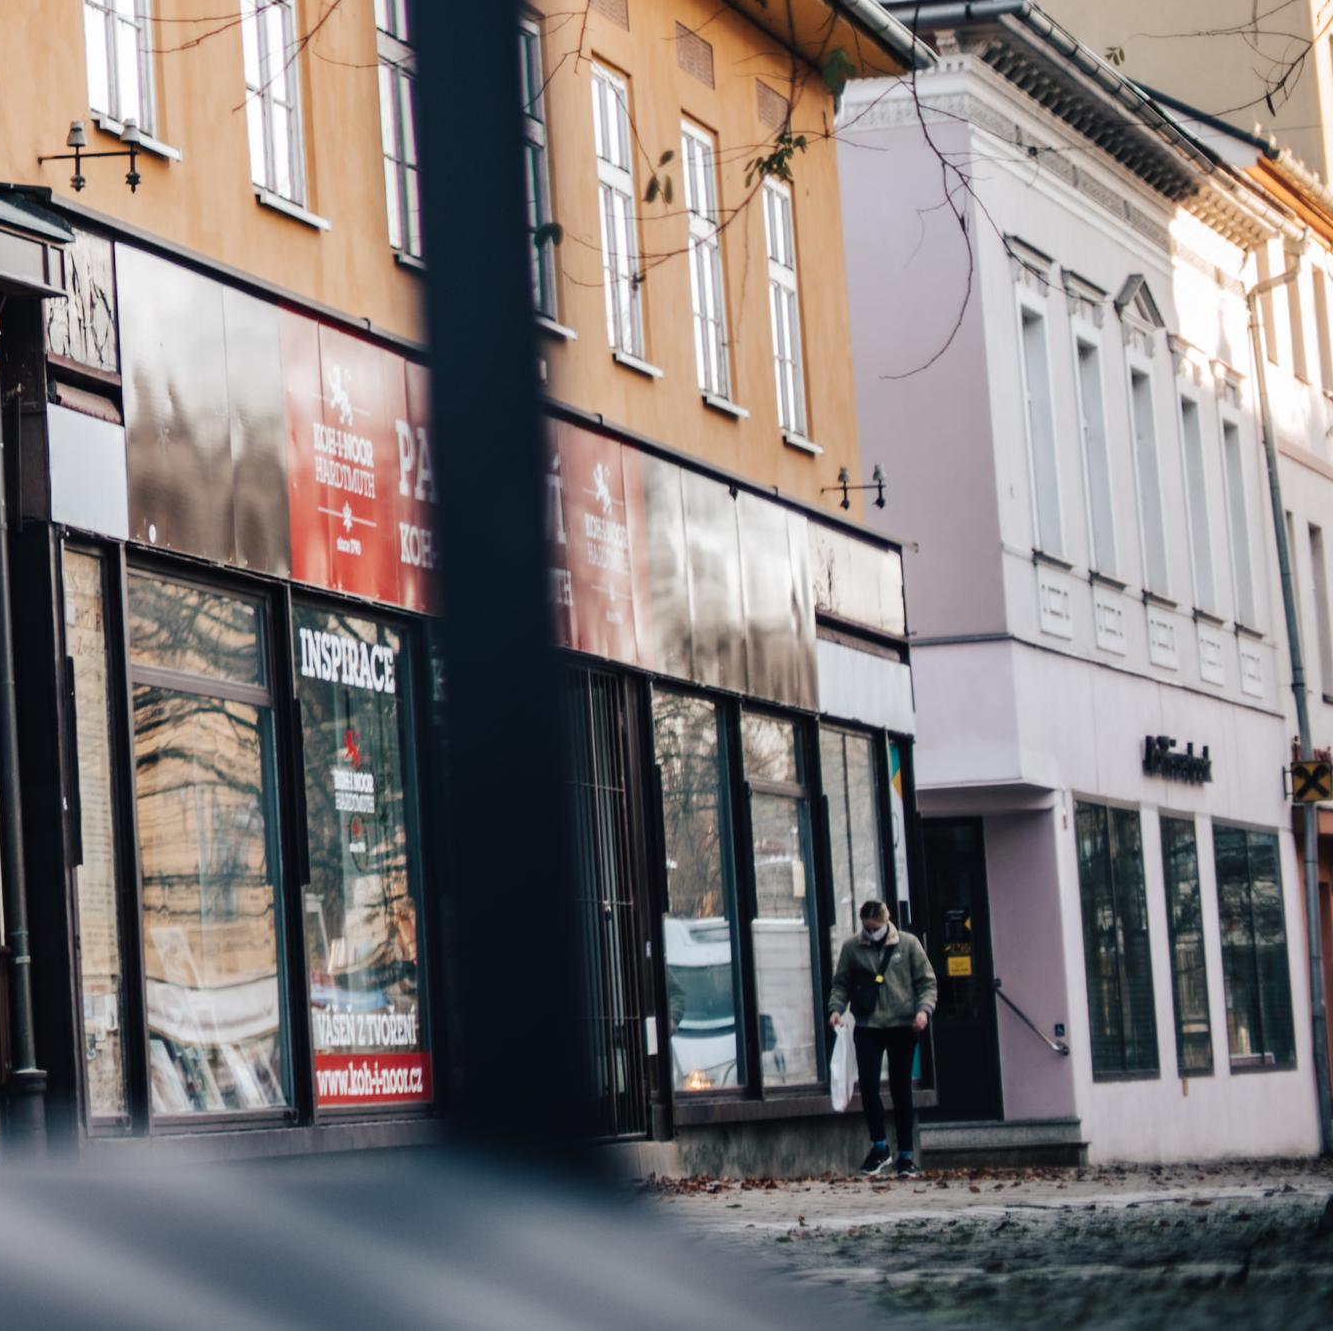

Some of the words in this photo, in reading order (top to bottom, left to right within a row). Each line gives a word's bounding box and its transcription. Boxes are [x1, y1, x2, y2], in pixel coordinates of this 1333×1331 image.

[313, 421, 374, 468] KOH-I-NOOR
[299, 626, 396, 695] INSPIRACE
[316, 1060, 423, 1097] www.koh-i-noor.cz
